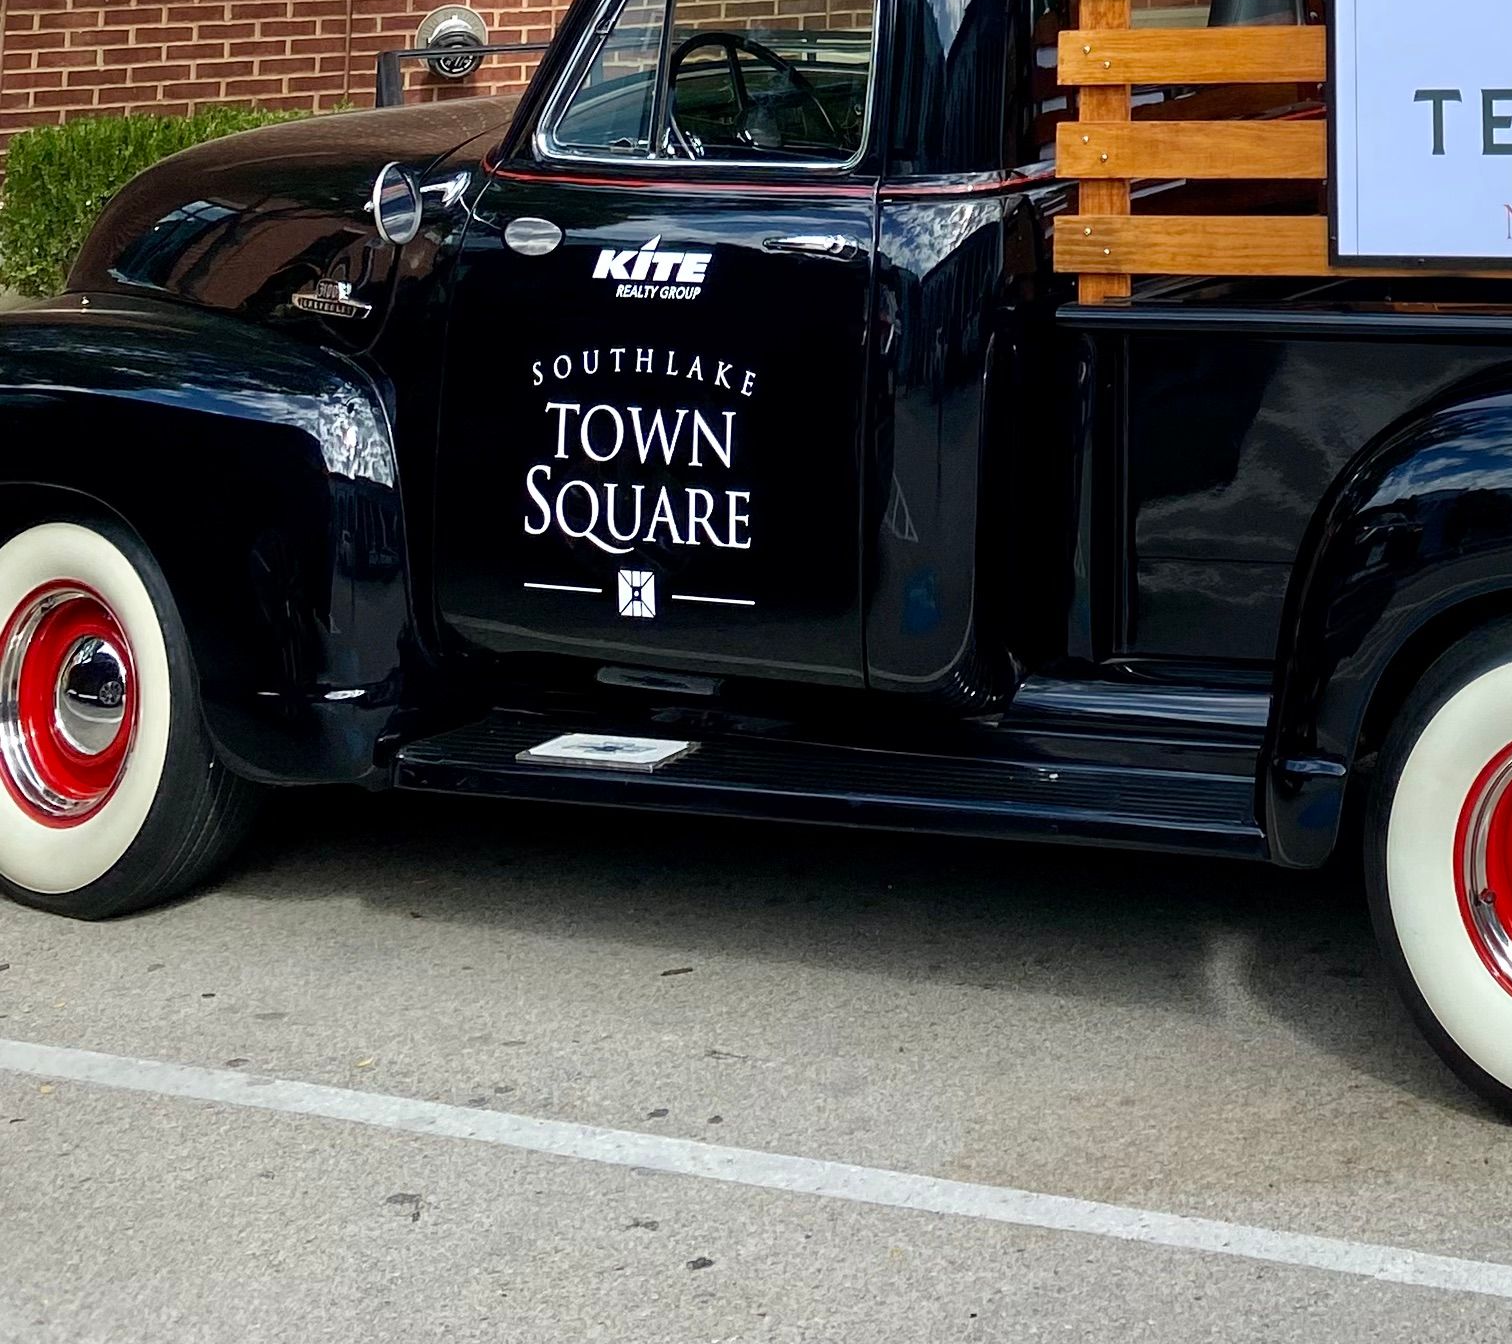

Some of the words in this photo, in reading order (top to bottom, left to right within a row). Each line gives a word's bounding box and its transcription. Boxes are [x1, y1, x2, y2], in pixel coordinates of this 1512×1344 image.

[616, 284, 659, 299] REALTY
[660, 285, 701, 300] GROUP
[532, 348, 756, 397] SOUTHLAKE
[545, 401, 736, 469] TOWN
[523, 465, 751, 554] SQUARE
